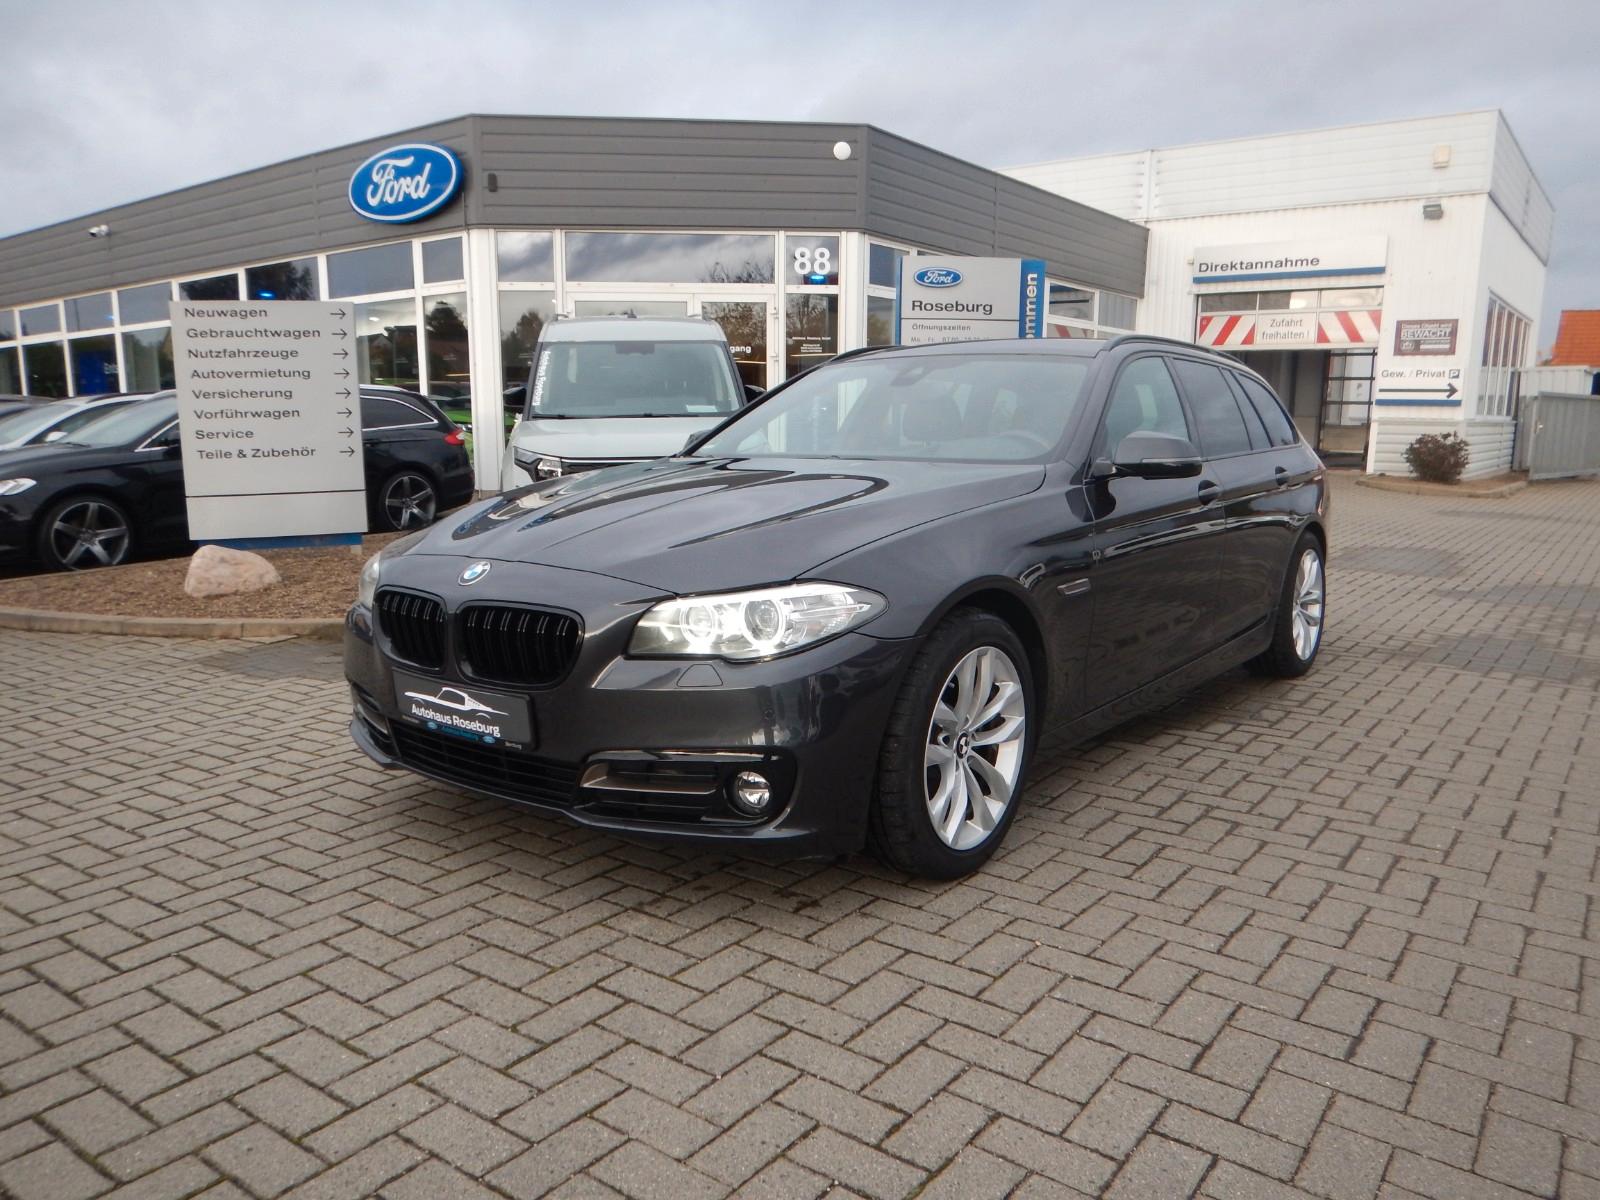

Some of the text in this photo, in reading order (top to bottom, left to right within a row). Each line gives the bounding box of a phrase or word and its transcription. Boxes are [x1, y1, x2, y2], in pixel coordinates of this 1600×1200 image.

[366, 155, 431, 207] Ford
[793, 246, 831, 275] 88
[1198, 257, 1321, 273] Direktannahme
[923, 270, 954, 284] Ford
[184, 307, 268, 319] Neuwagen
[911, 300, 993, 315] Roseburg
[911, 322, 971, 332] Öffnungszeiten
[1269, 318, 1304, 328] Zufahrt
[186, 328, 321, 340] Gebrauchtwagen
[1261, 331, 1305, 340] freihalten
[1401, 328, 1452, 338] BEWACHT
[188, 348, 299, 360] Nutzfahrzeuge
[729, 345, 752, 354] gang
[191, 368, 311, 380] Autovermietung
[1381, 369, 1406, 378] Gew.
[1415, 369, 1446, 378] Privat
[192, 389, 293, 400] Versicherung
[193, 408, 300, 420] Vorführwagen
[195, 429, 254, 440] Service
[197, 446, 316, 460] Teile & Zubehör
[411, 703, 453, 725] Autohaus
[452, 715, 501, 738] Roseburg
